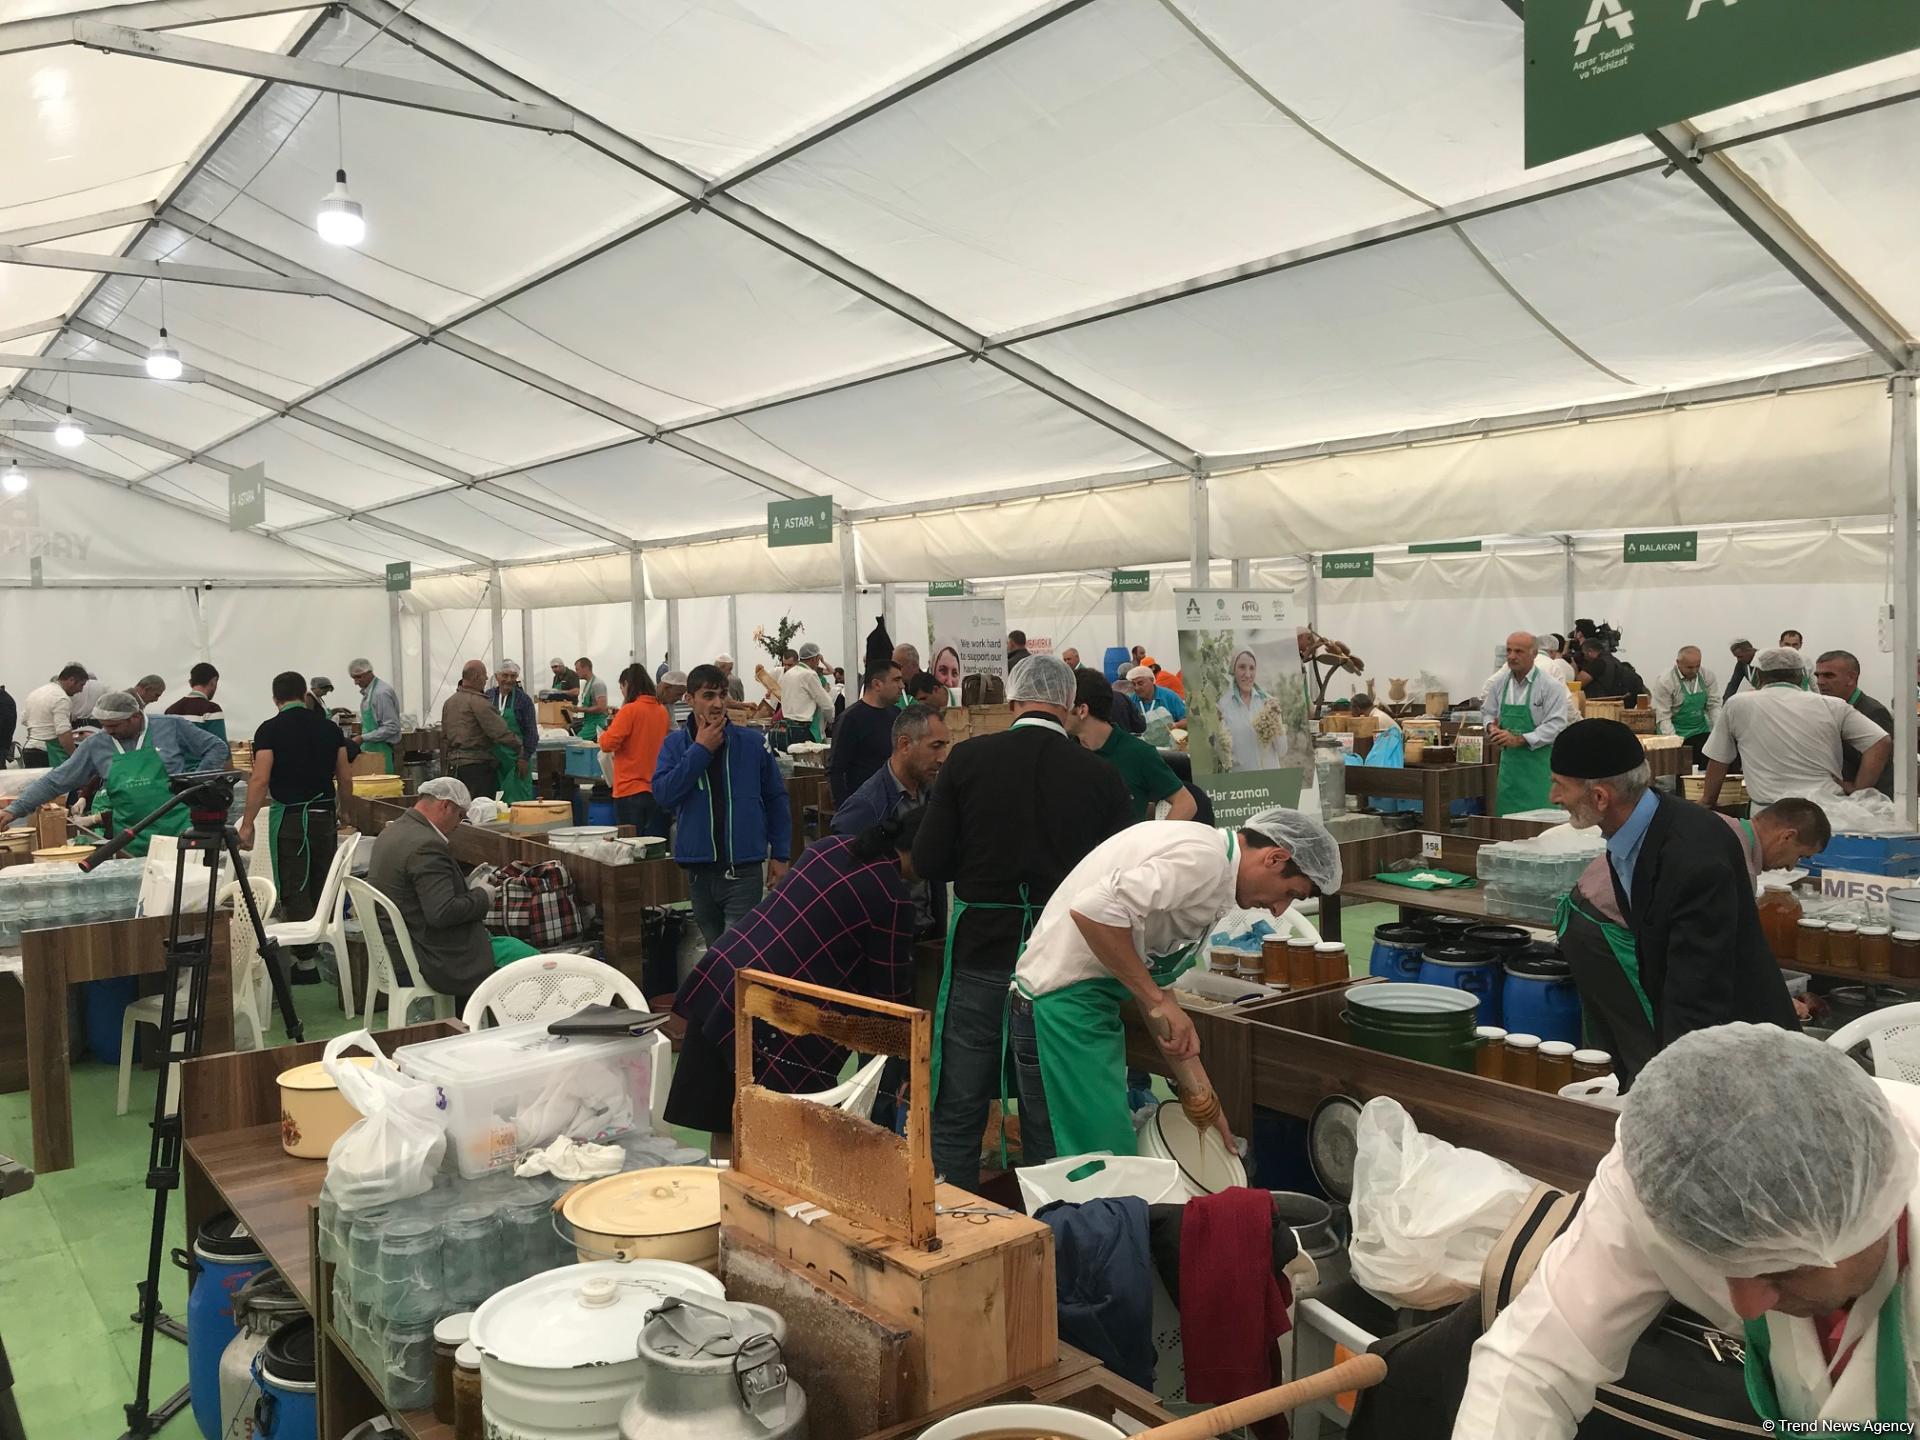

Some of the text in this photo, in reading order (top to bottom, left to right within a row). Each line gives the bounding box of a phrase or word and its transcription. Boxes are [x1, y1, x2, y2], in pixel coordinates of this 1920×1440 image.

[1573, 57, 1598, 72] Aqrar
[784, 515, 815, 529] ASTARA
[1639, 543, 1681, 552] BALAKƏN
[971, 638, 986, 648] work
[987, 639, 1001, 648] hard
[967, 653, 989, 663] support
[1230, 787, 1270, 800] zaman
[1425, 842, 1439, 851] 158
